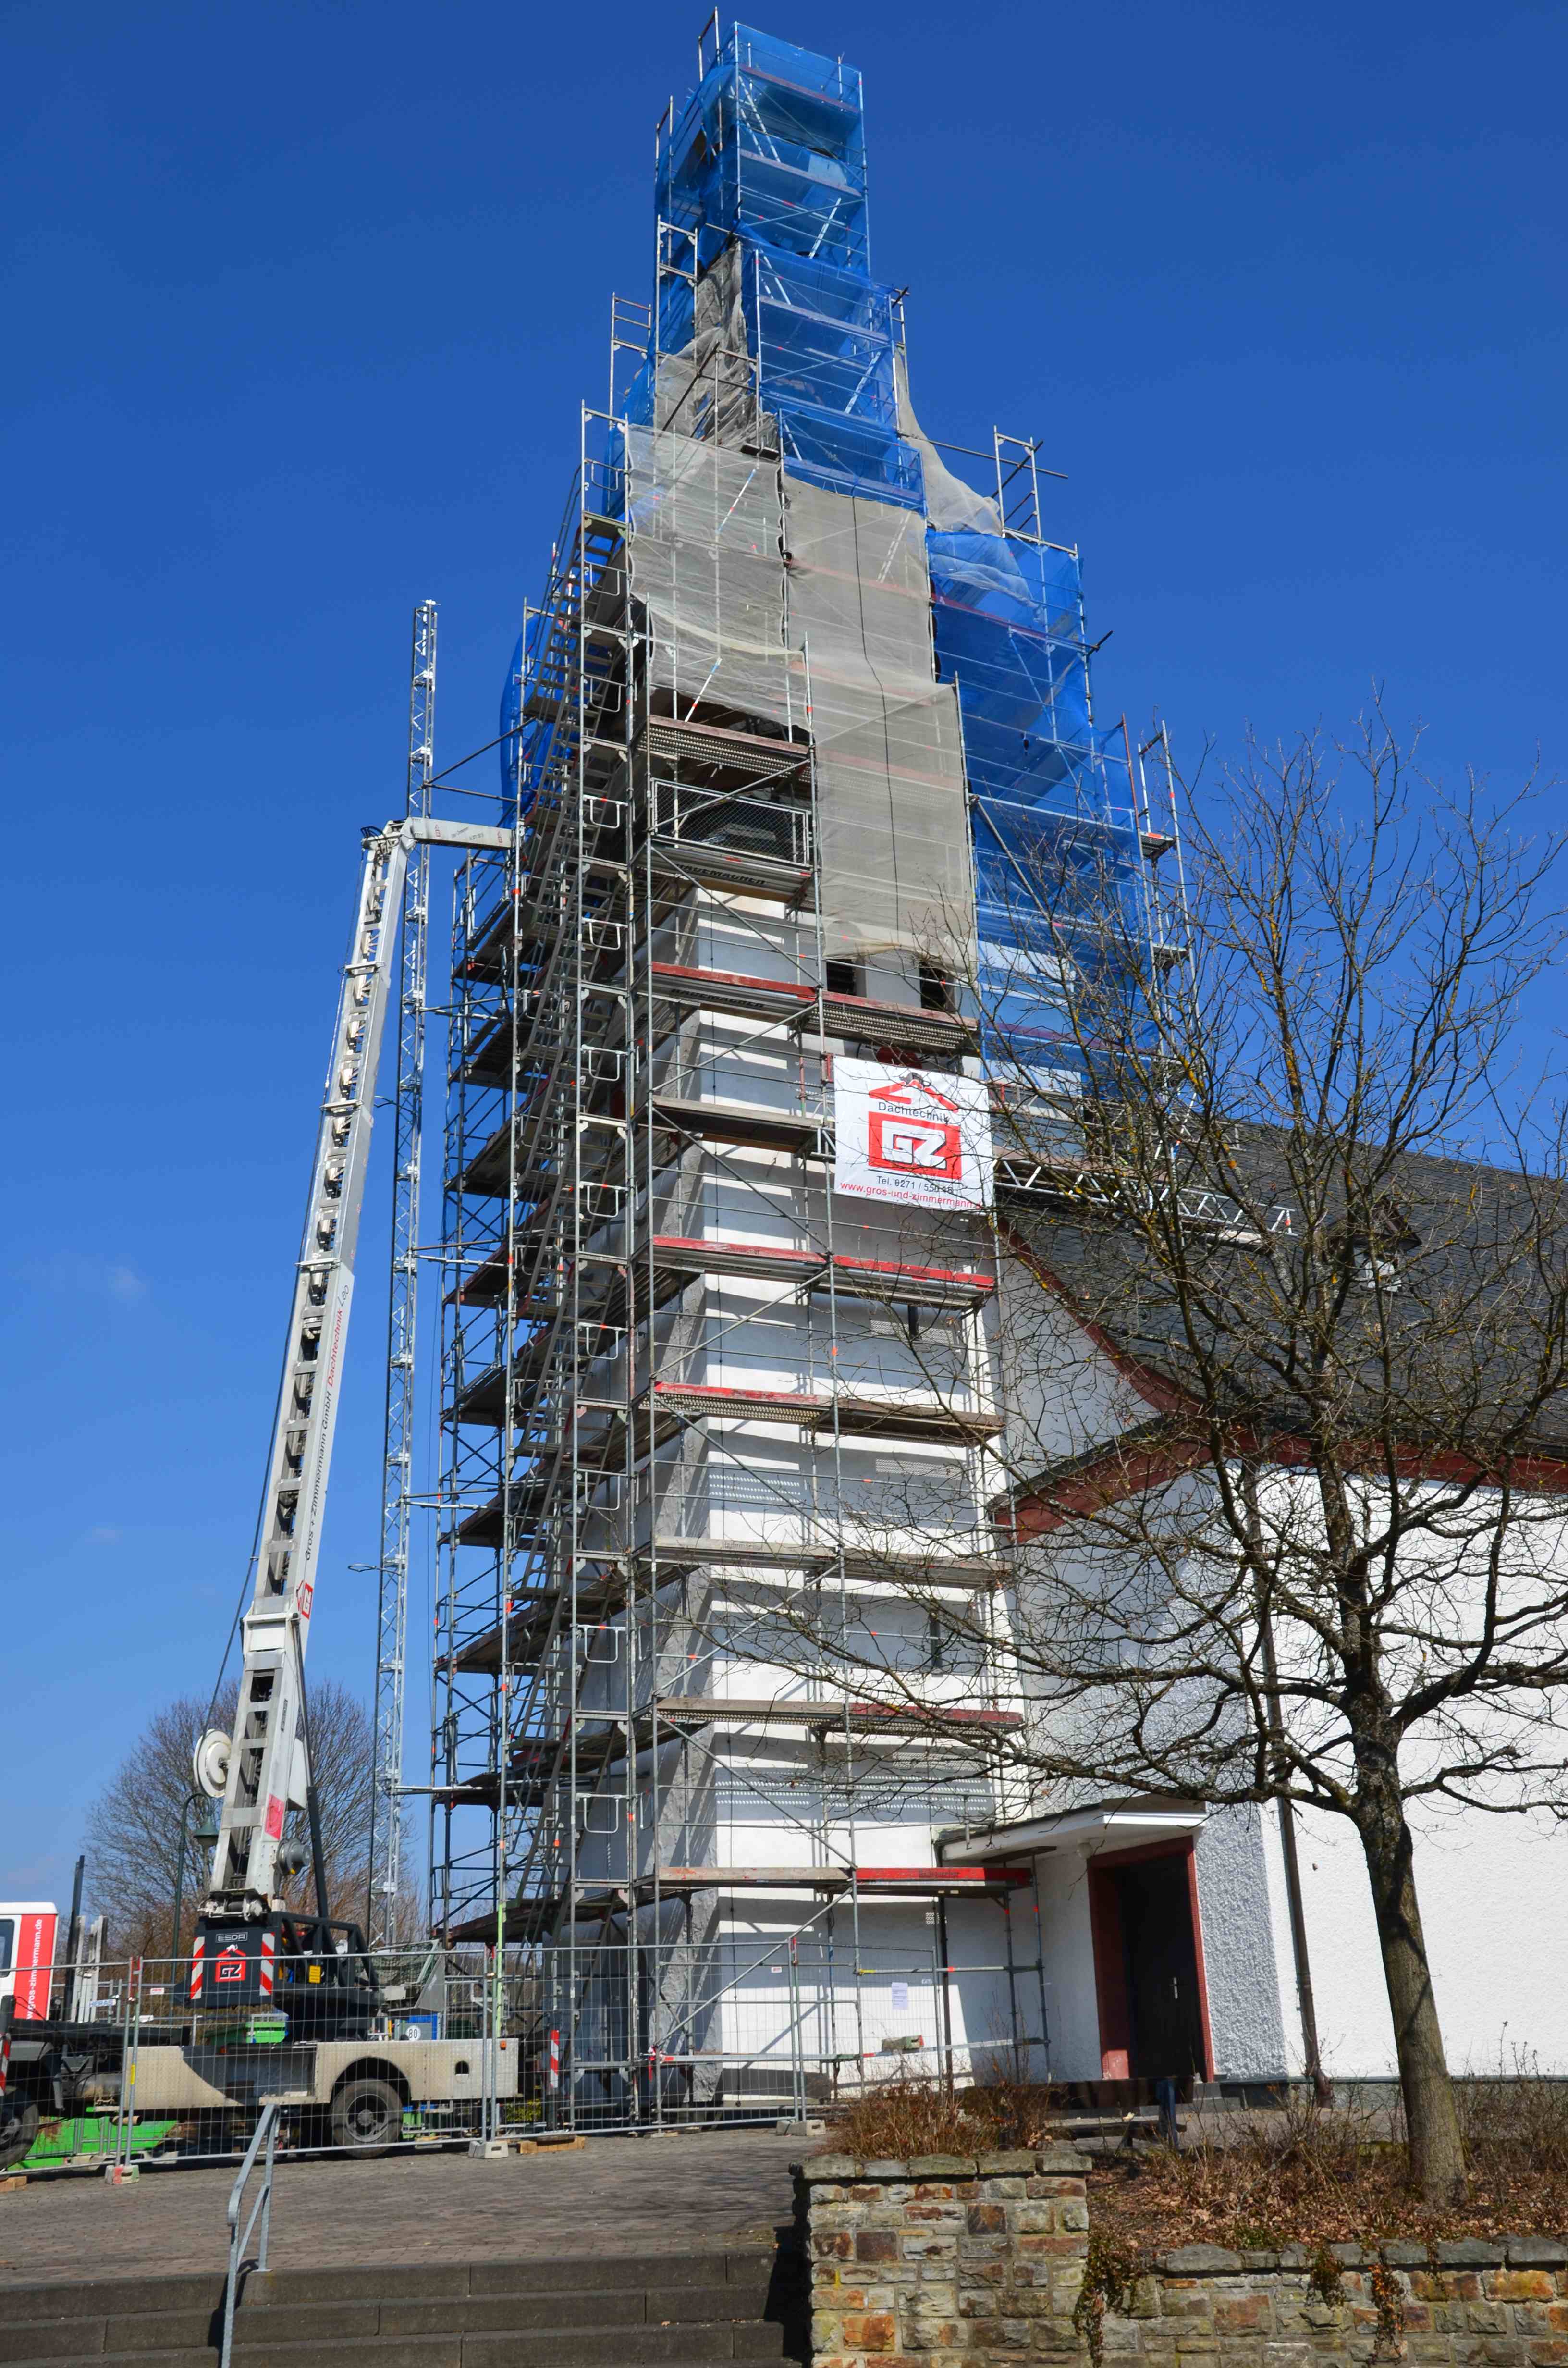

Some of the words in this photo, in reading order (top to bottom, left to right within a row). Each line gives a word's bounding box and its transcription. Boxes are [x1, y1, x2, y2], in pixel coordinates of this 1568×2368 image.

[878, 1102, 950, 1123] Dachtechnik
[882, 1120, 948, 1171] GZ
[876, 1175, 892, 1186] Tel.
[918, 1182, 922, 1190] /
[840, 1182, 984, 1210] www.gros-und-zimmermann.d
[305, 1530, 314, 1561] Gros
[311, 1432, 326, 1517] Zimmermann
[321, 1393, 331, 1430] GmbH
[327, 1309, 343, 1387] Dachtechnik
[218, 1934, 245, 1942] ESDA
[408, 2029, 418, 2038] 80
